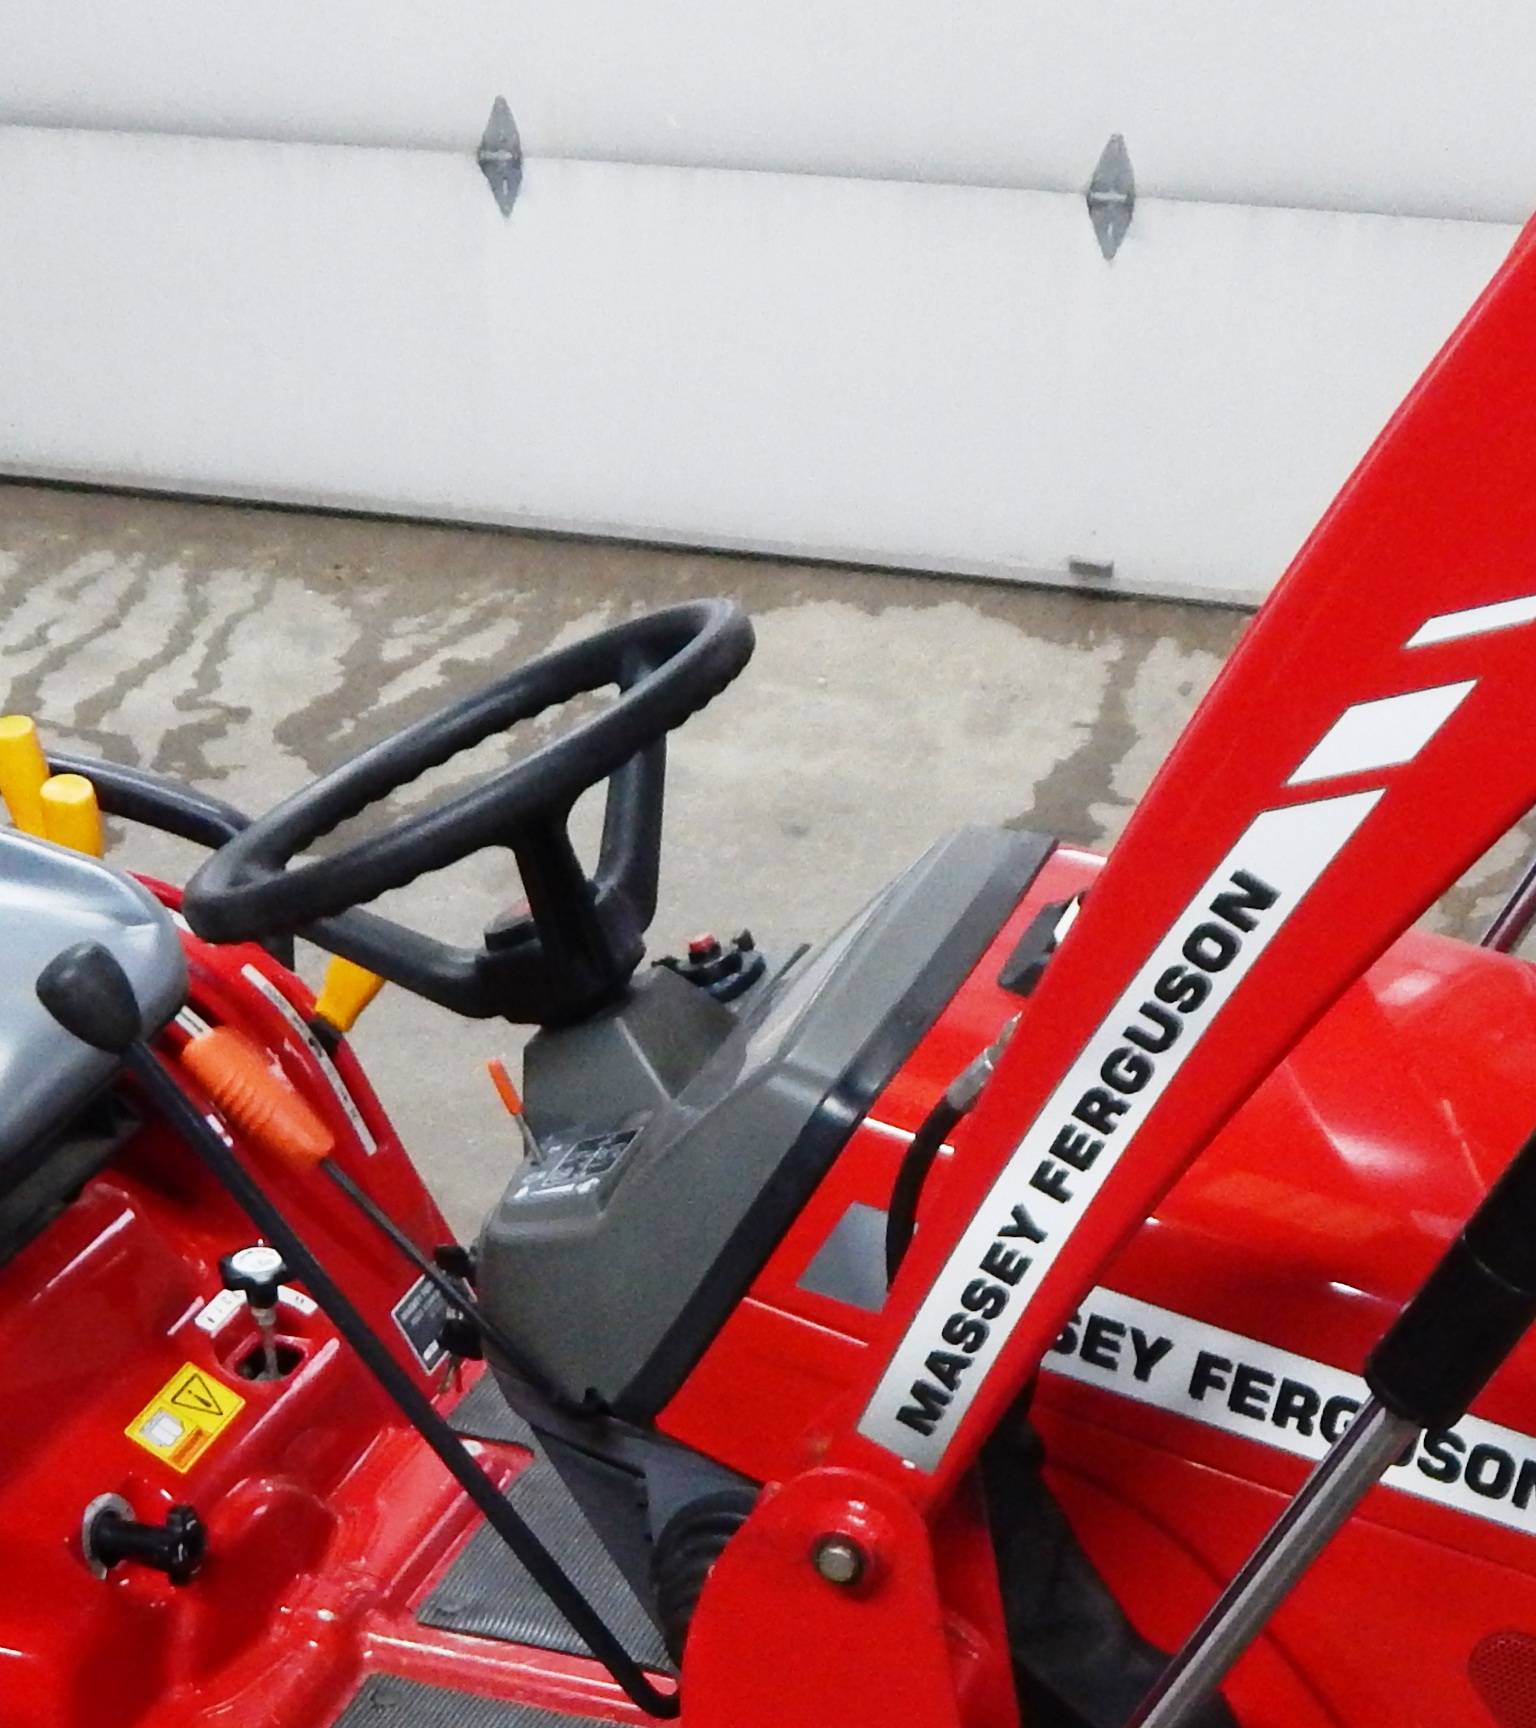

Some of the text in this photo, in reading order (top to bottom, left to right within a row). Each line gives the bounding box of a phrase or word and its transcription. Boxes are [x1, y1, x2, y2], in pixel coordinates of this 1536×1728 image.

[895, 868, 1281, 1437] MASSEY FERGUSON
[1052, 1310, 1174, 1383] SEY
